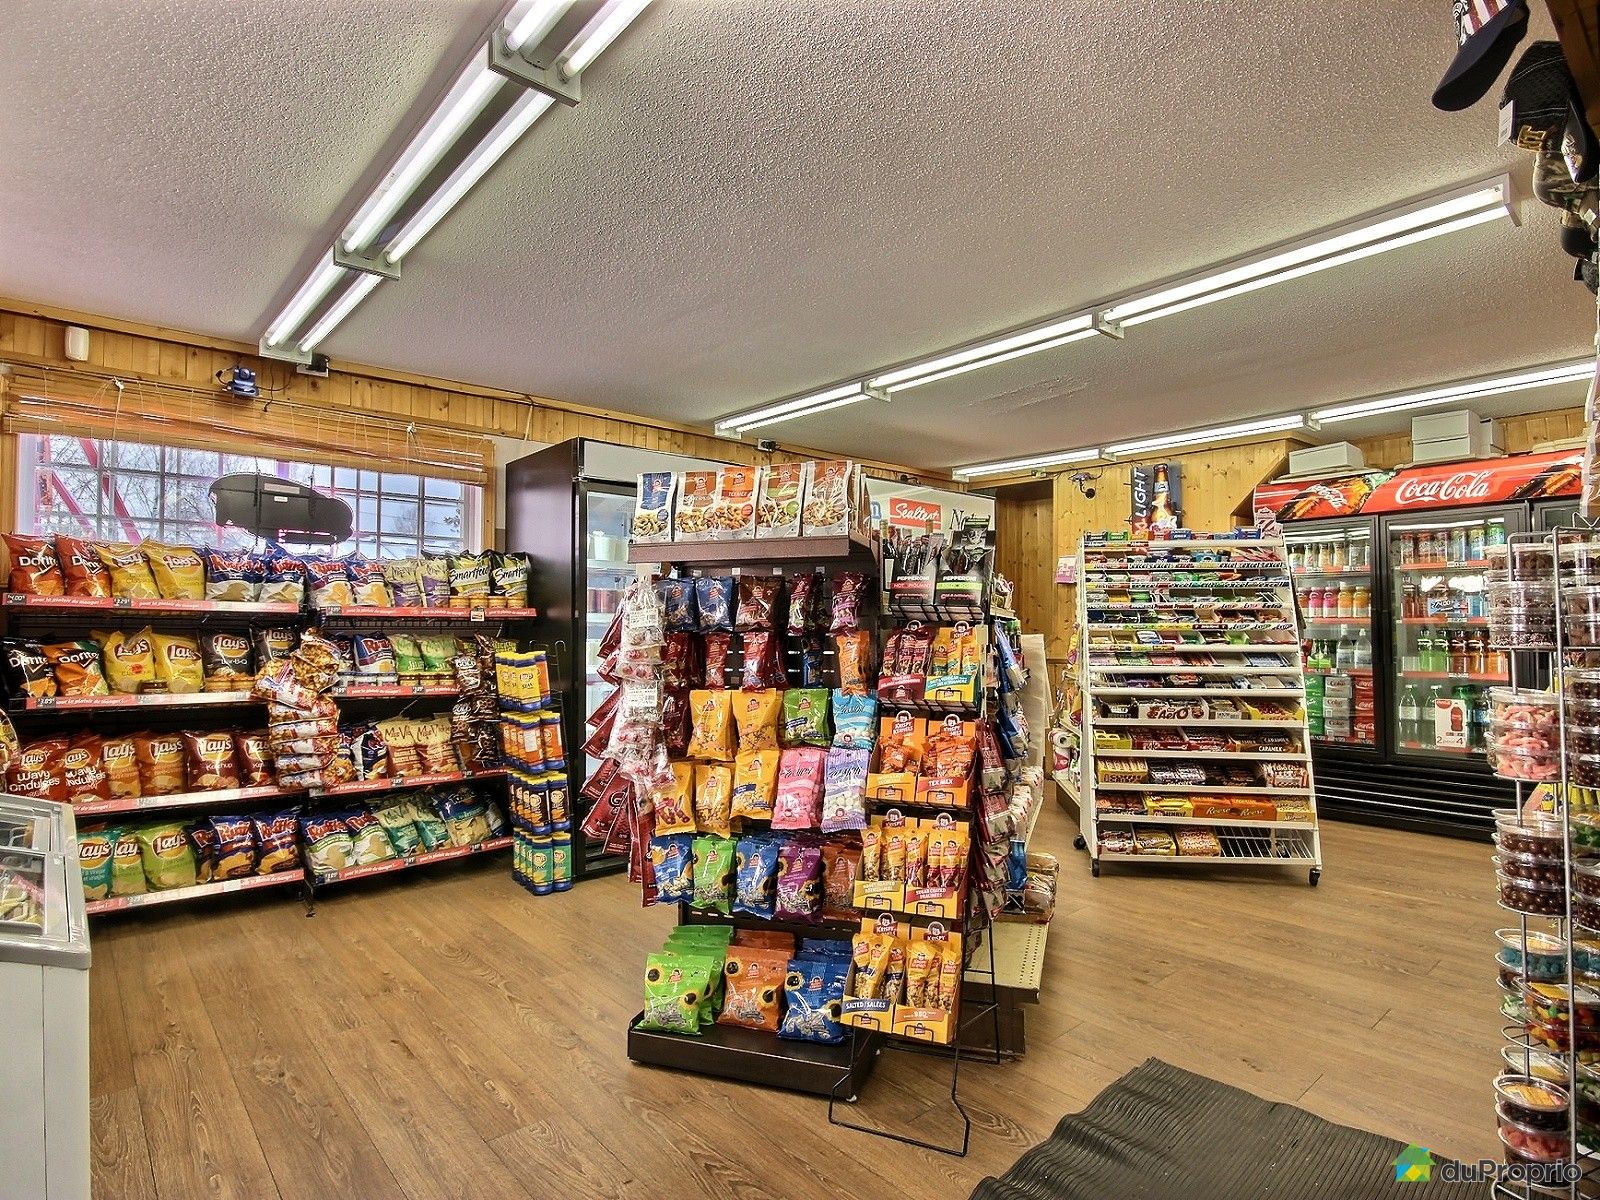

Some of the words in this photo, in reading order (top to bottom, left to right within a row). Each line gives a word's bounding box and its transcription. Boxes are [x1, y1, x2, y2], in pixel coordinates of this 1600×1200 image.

[1133, 467, 1147, 518] LIGHT
[1395, 469, 1498, 504] Coca-Cola
[895, 502, 940, 520] Sealtest
[1436, 735, 1443, 744] 2
[1206, 806, 1231, 815] Reese
[1240, 808, 1264, 816] Reese
